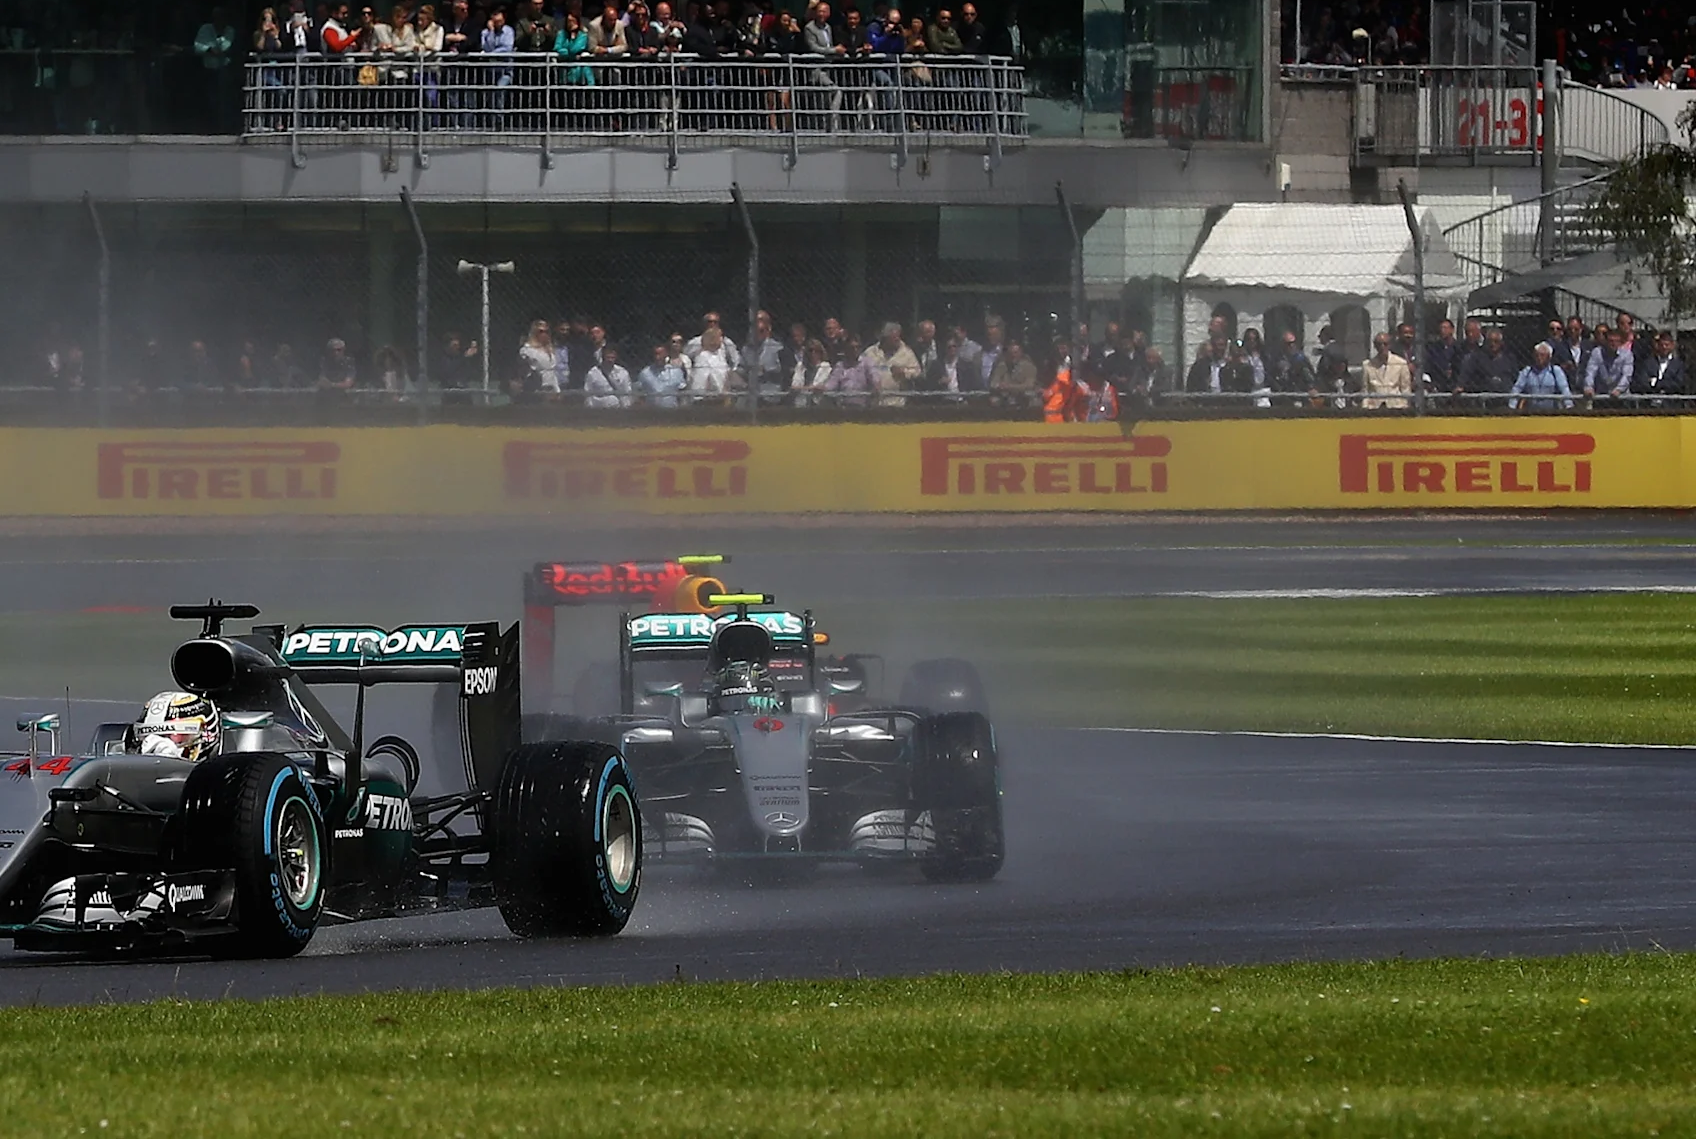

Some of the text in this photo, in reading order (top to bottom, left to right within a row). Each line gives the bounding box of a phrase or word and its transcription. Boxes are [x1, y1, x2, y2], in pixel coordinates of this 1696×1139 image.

[1459, 98, 1544, 151] 21-3
[96, 440, 341, 499] PIRELLI
[503, 439, 752, 499] PIRELLI
[920, 434, 1173, 494] PIRELLI
[1339, 432, 1596, 493] PIRELLI
[285, 630, 464, 654] PETRONA
[632, 616, 803, 637] PETRAS
[464, 667, 498, 695] EPSON
[334, 828, 364, 838] PETRONAS
